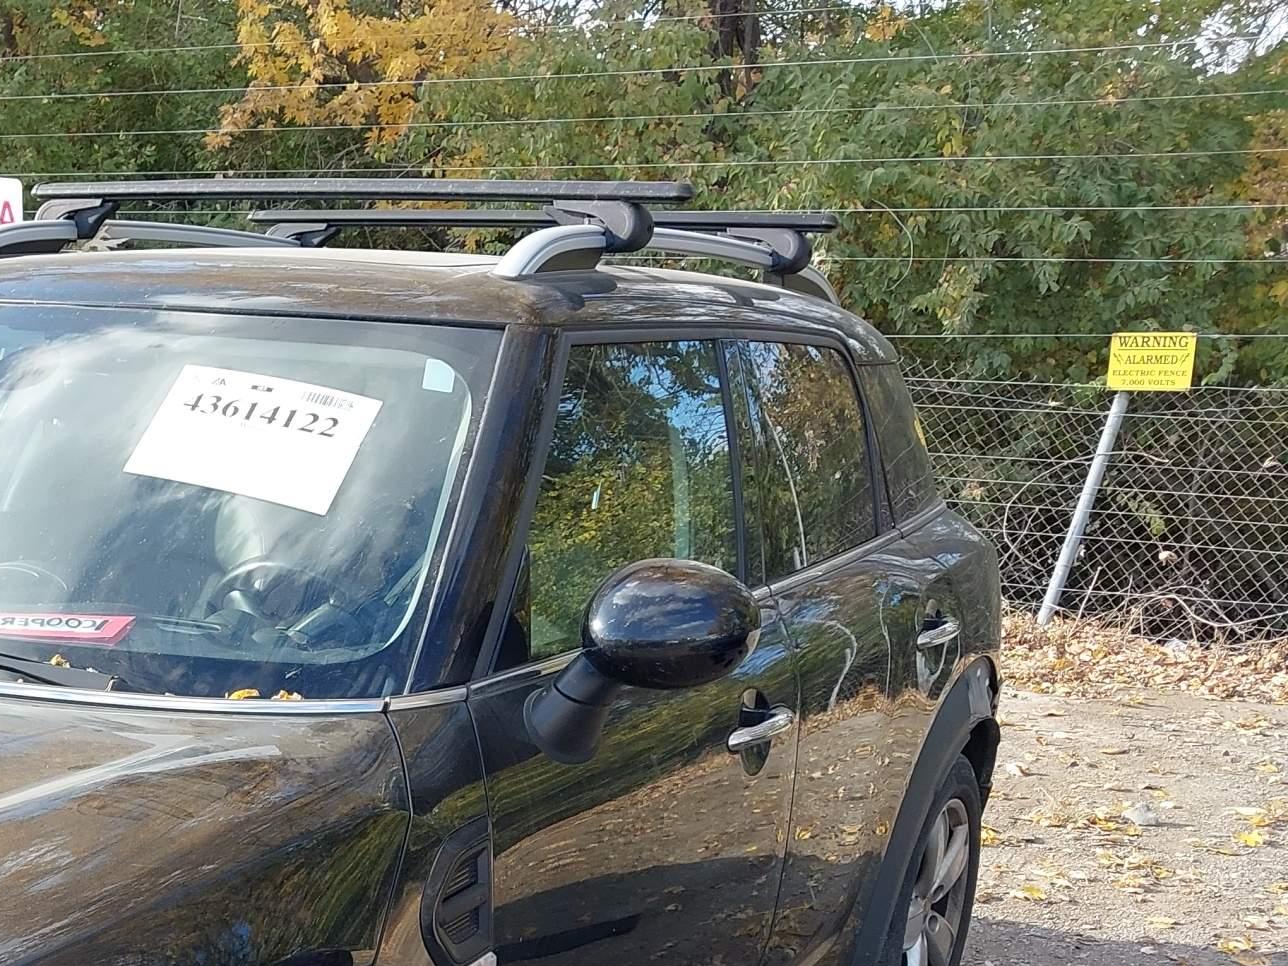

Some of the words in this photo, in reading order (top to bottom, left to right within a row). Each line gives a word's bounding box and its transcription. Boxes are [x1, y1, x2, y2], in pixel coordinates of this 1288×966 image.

[1118, 335, 1190, 348] WARNING
[1124, 354, 1179, 365] ALARMED
[1112, 369, 1156, 377] ELECTRIC
[1158, 369, 1189, 377] FENCE
[184, 392, 339, 438] 43614122
